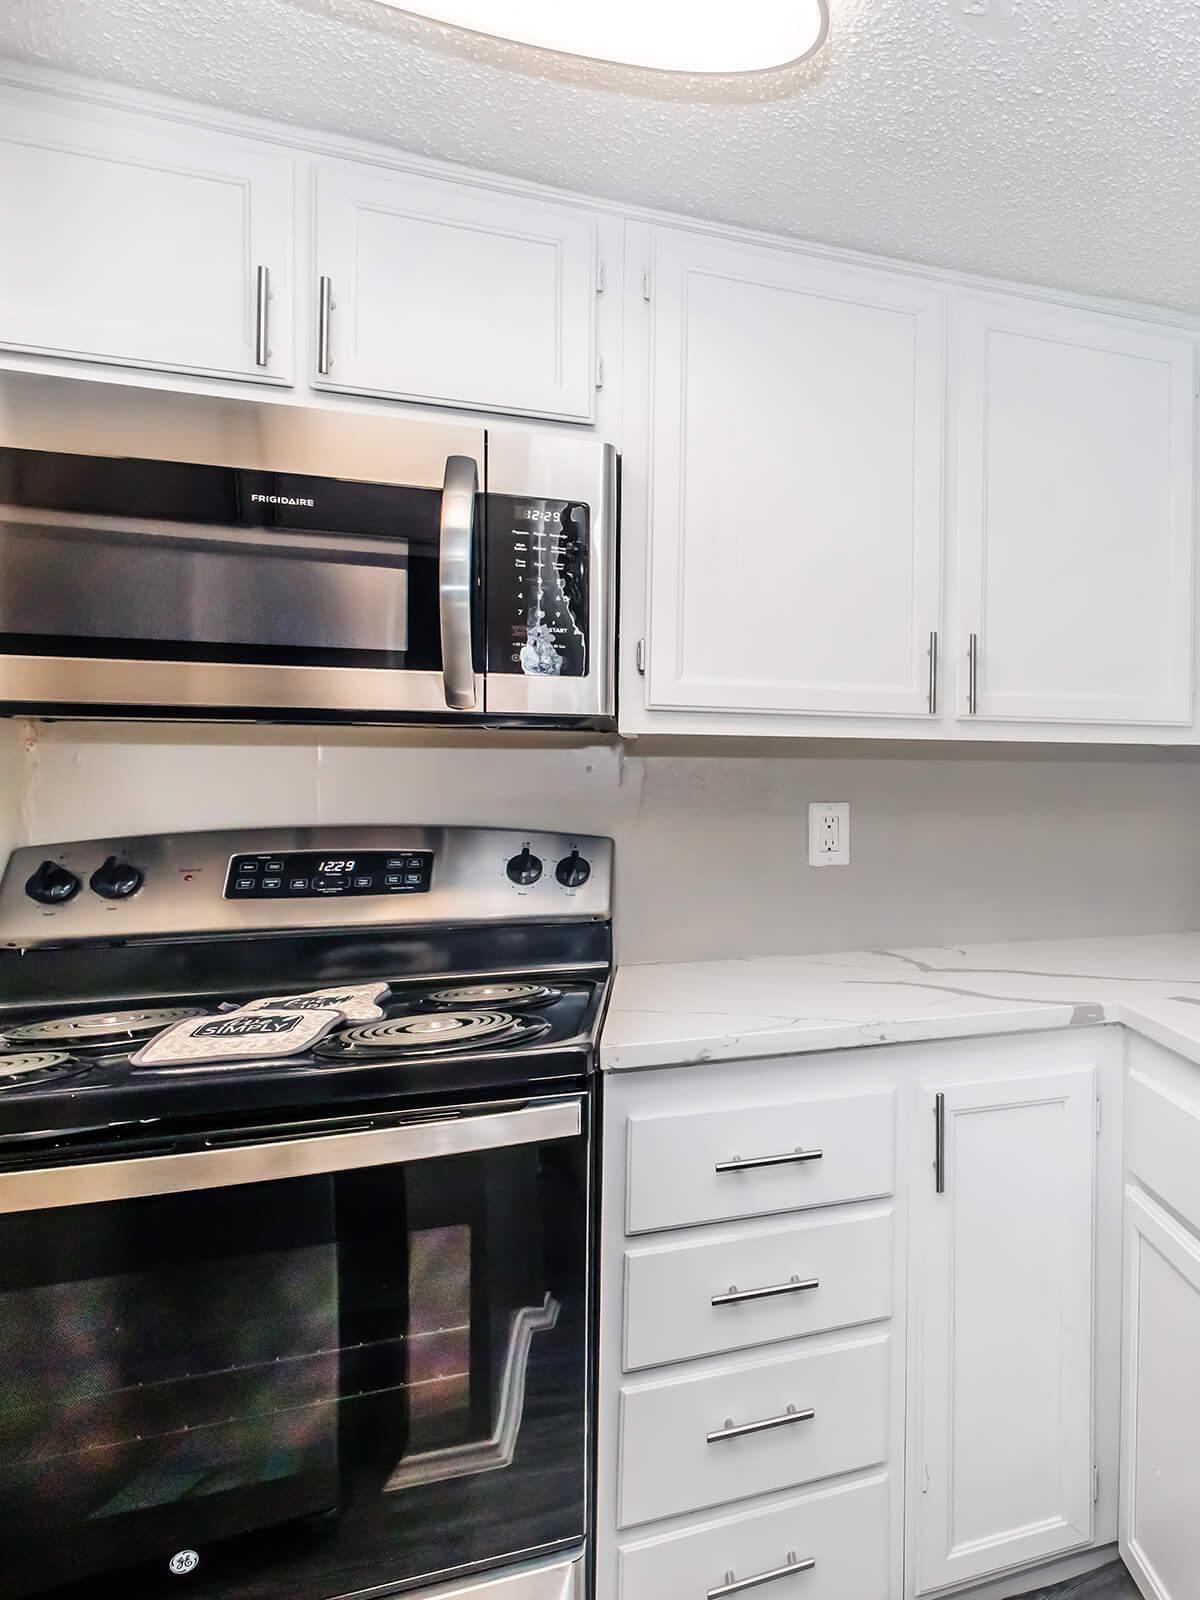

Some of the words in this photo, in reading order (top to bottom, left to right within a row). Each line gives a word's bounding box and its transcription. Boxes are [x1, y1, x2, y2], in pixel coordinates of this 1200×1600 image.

[251, 494, 314, 507] FRIGIDAIRE
[527, 509, 561, 522] 12:29
[201, 1022, 289, 1035] SIMPLY
